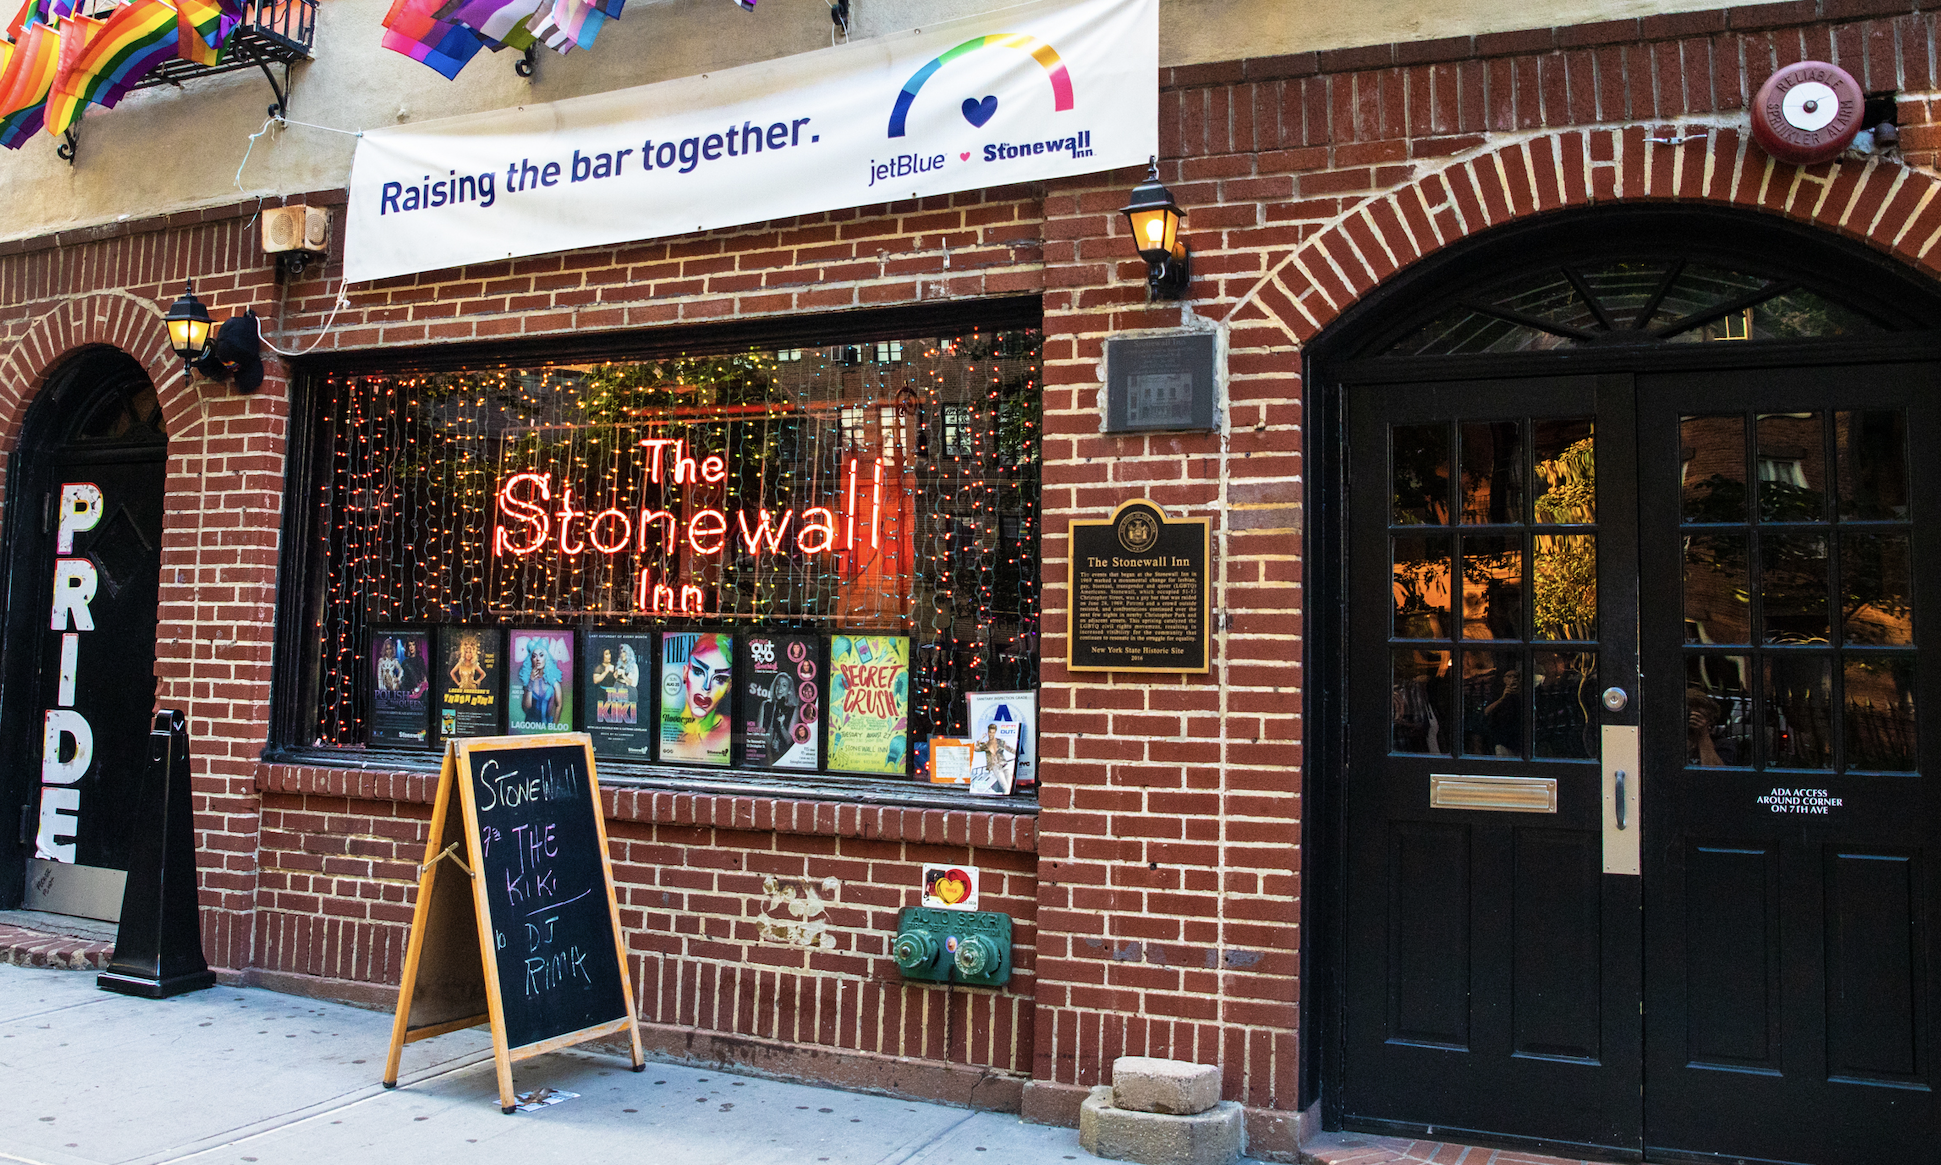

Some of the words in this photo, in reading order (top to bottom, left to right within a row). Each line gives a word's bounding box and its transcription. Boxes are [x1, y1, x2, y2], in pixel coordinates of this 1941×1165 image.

[1776, 70, 1844, 93] RELIABLE
[1826, 100, 1854, 138] ALARM
[983, 130, 1090, 162] Stonewall
[1072, 149, 1093, 159] Inn
[380, 170, 496, 216] Raising
[506, 157, 561, 193] the
[570, 148, 634, 183] bar
[642, 116, 820, 174] together.
[868, 153, 946, 187] jetBlue
[639, 438, 726, 484] The
[495, 457, 883, 557] Stonewall
[1087, 556, 1108, 568] The
[1112, 556, 1167, 568] Stonewall
[1171, 556, 1190, 567] Inn
[638, 567, 704, 612] Inn
[665, 634, 686, 664] THE
[34, 482, 104, 864] PRIDE
[840, 664, 904, 690] SECRET
[374, 690, 410, 700] POLISH
[606, 687, 628, 702] THE
[843, 688, 899, 719] CRUSH
[511, 721, 547, 730] LAGOONA
[548, 722, 569, 731] BLOO
[597, 700, 637, 724] KIKI
[1756, 796, 1800, 805] AROUND
[1802, 798, 1843, 807] CORNER
[1771, 788, 1792, 797] ADA
[1793, 788, 1828, 798] ACCESS
[1771, 804, 1787, 813] ON
[1789, 806, 1809, 814] 7TH
[1810, 806, 1828, 814] AVE
[512, 823, 558, 873] THE
[910, 909, 950, 924] AUTO
[958, 912, 998, 927] SPKR
[525, 916, 559, 953] DJ
